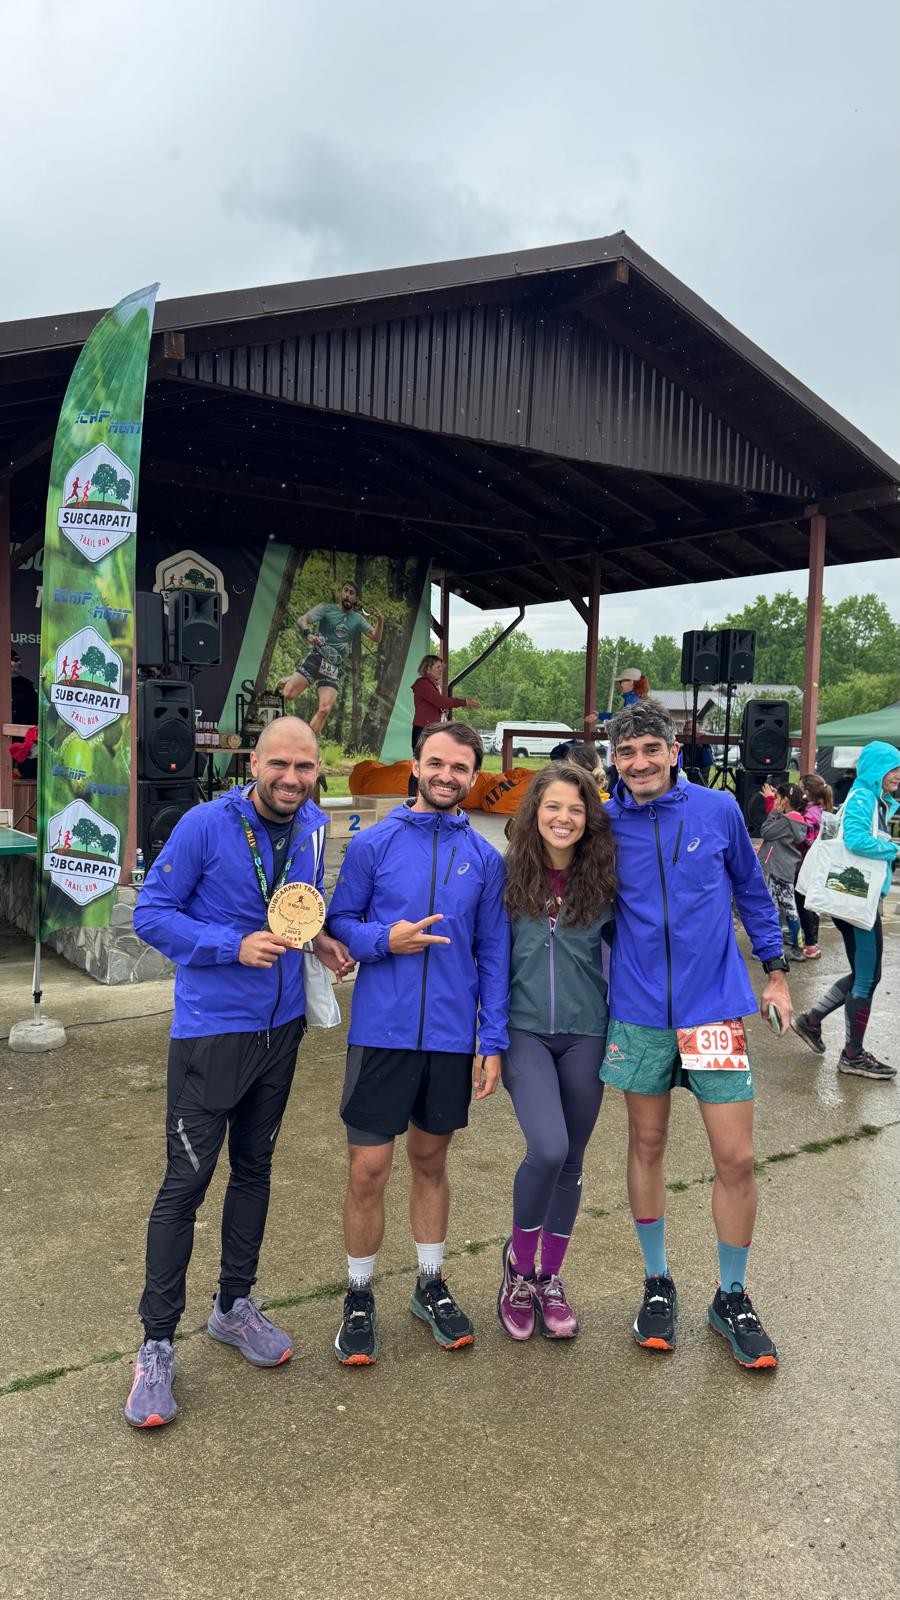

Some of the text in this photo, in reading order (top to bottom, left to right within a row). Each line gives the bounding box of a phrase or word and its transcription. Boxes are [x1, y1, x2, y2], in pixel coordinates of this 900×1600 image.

[62, 511, 131, 528] SUBCARPATI
[80, 534, 110, 548] TRAIL RUN
[55, 688, 121, 710] SUBCARPATI
[71, 711, 99, 725] TRAIL RUN
[348, 814, 361, 831] 2
[64, 878, 98, 892] TRAIL RUN
[269, 883, 302, 914] SUBCARPATI
[304, 885, 320, 901] TRAIL
[701, 1029, 729, 1051] 319
